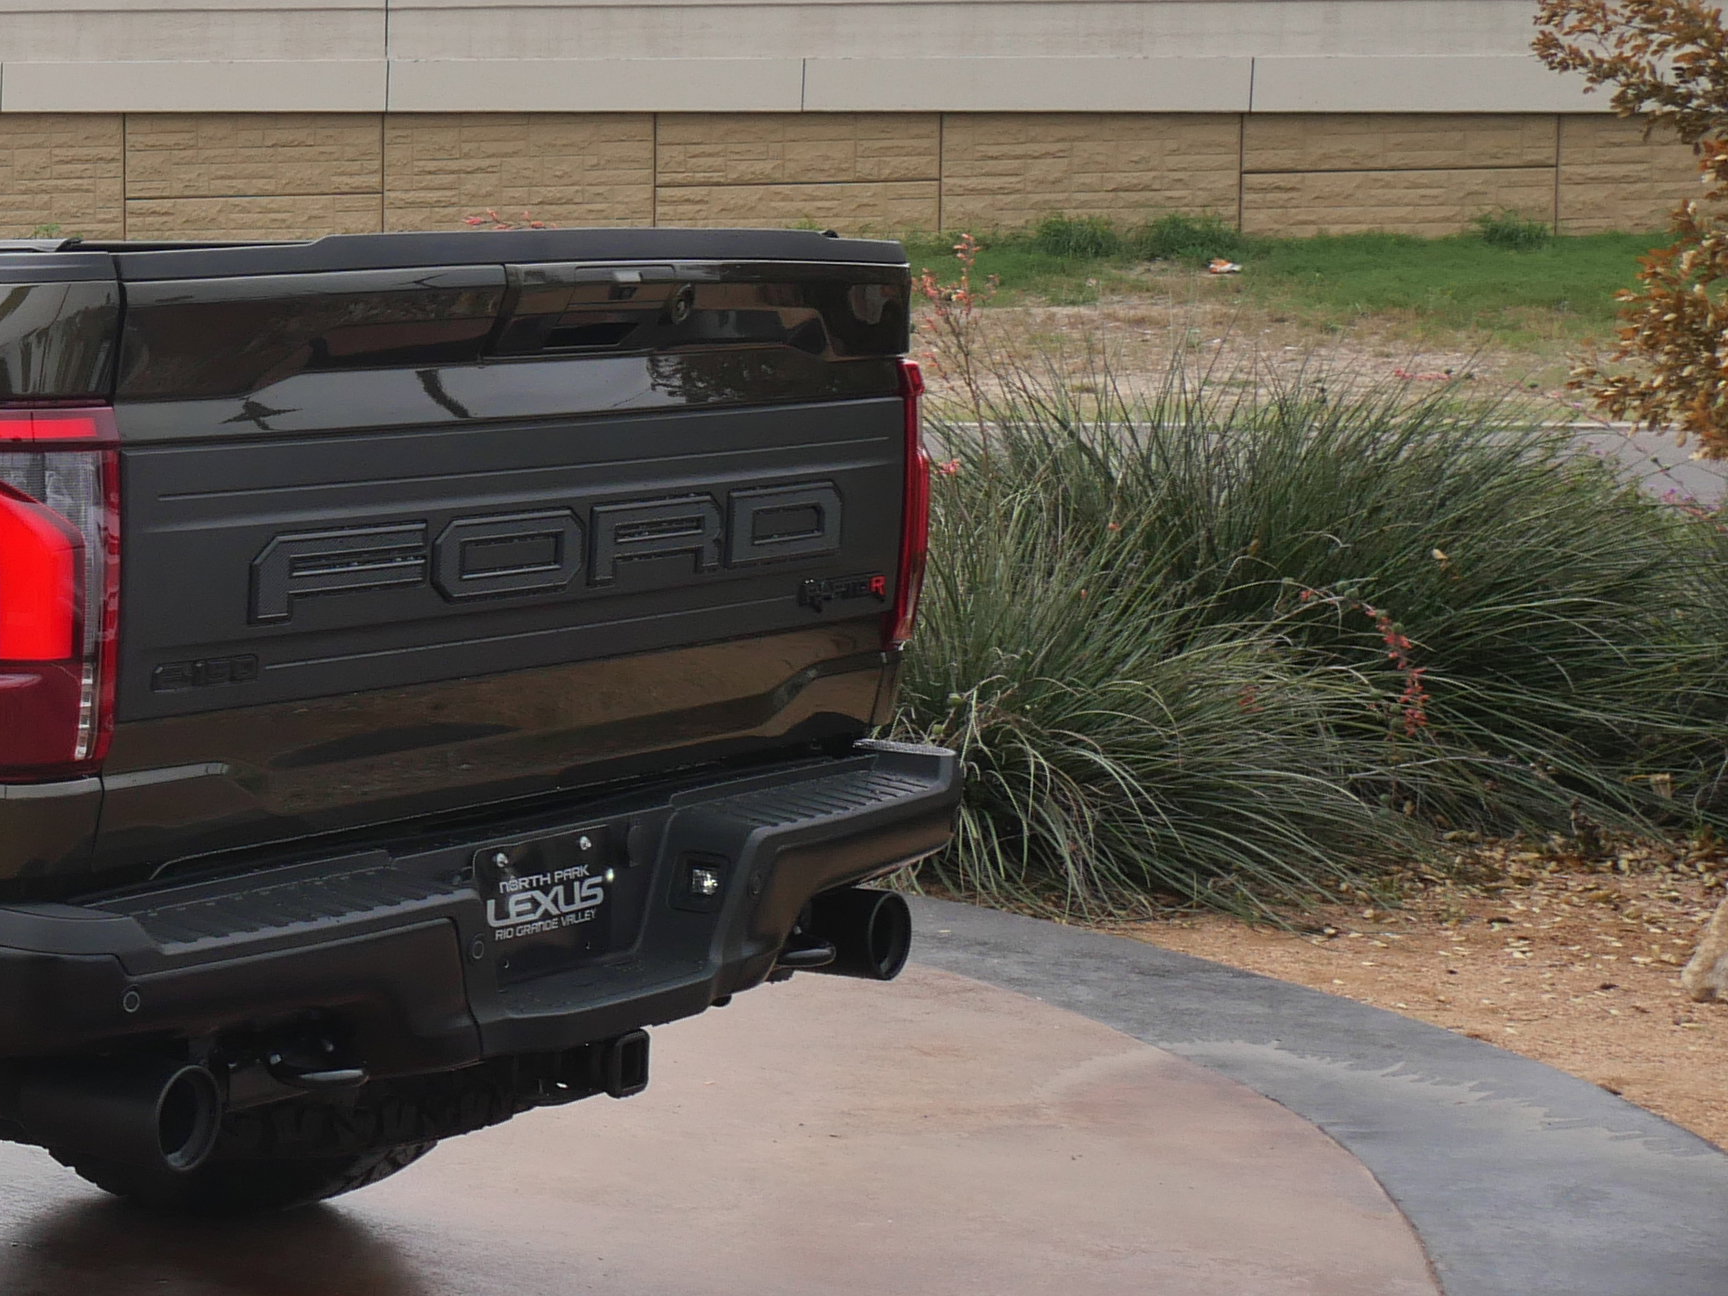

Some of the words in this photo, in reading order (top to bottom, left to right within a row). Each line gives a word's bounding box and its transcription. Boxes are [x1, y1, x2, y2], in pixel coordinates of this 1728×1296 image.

[247, 480, 841, 625] FORD
[499, 872, 551, 894] NORTH
[554, 864, 590, 883] PARK
[486, 875, 604, 928] LEXUS
[495, 927, 514, 941] RIO
[516, 917, 559, 937] GRANDE
[560, 908, 597, 926] VALLEY
